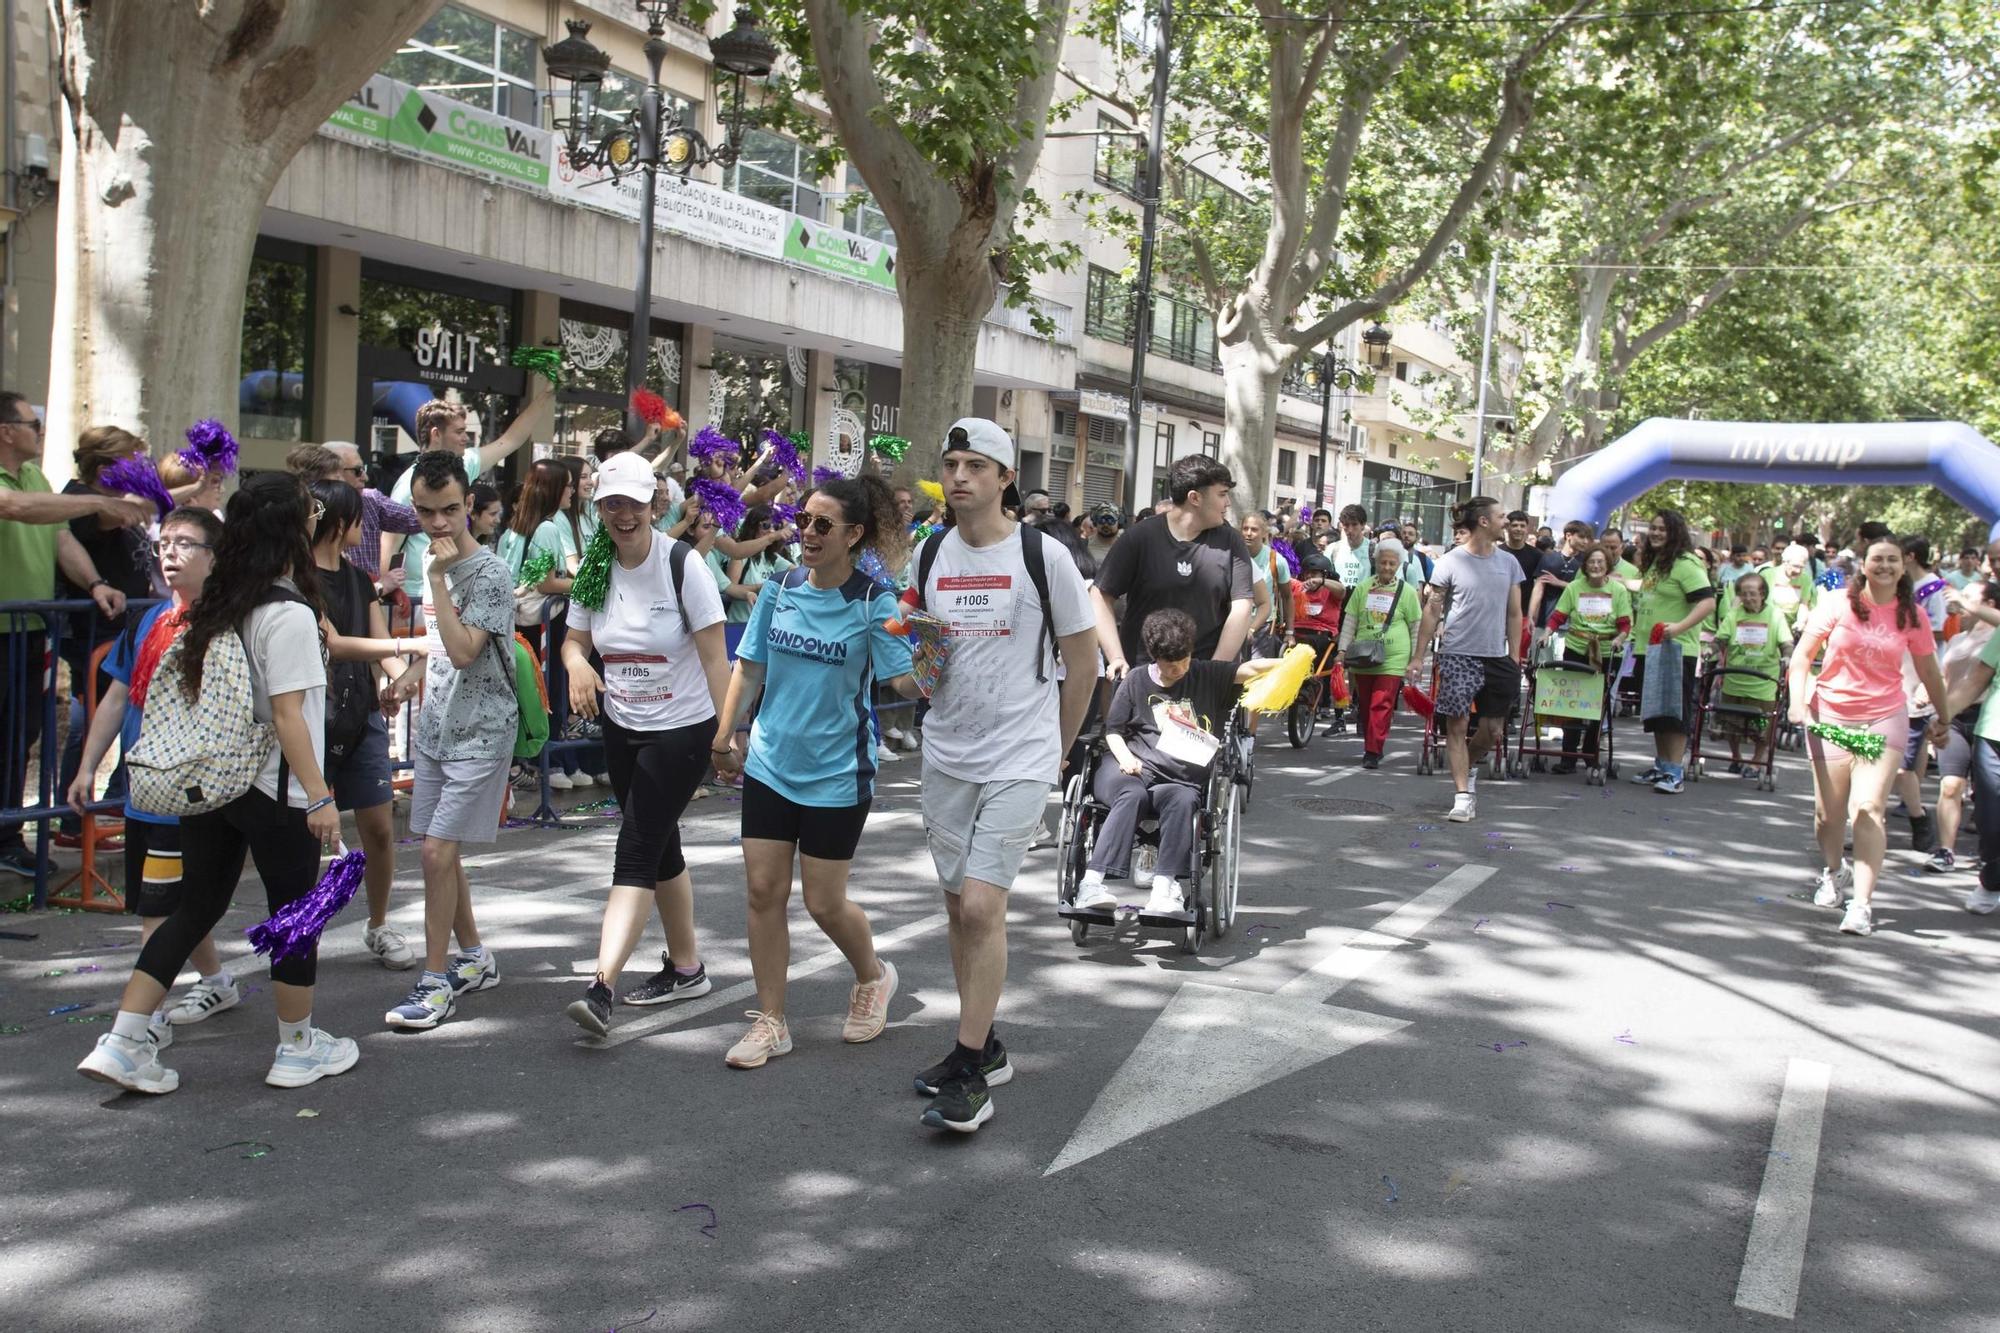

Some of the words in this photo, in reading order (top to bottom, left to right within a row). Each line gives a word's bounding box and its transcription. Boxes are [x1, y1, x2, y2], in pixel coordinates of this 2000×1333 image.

[711, 194, 721, 208] DE
[654, 194, 704, 220] BIBLIOTECA
[706, 210, 749, 235] MUNICIPAL
[416, 327, 481, 374] SAIT
[419, 370, 470, 385] RESTAURANT
[1730, 431, 1866, 470] mychip
[955, 594, 989, 606] #1005
[621, 667, 650, 677] #1005
